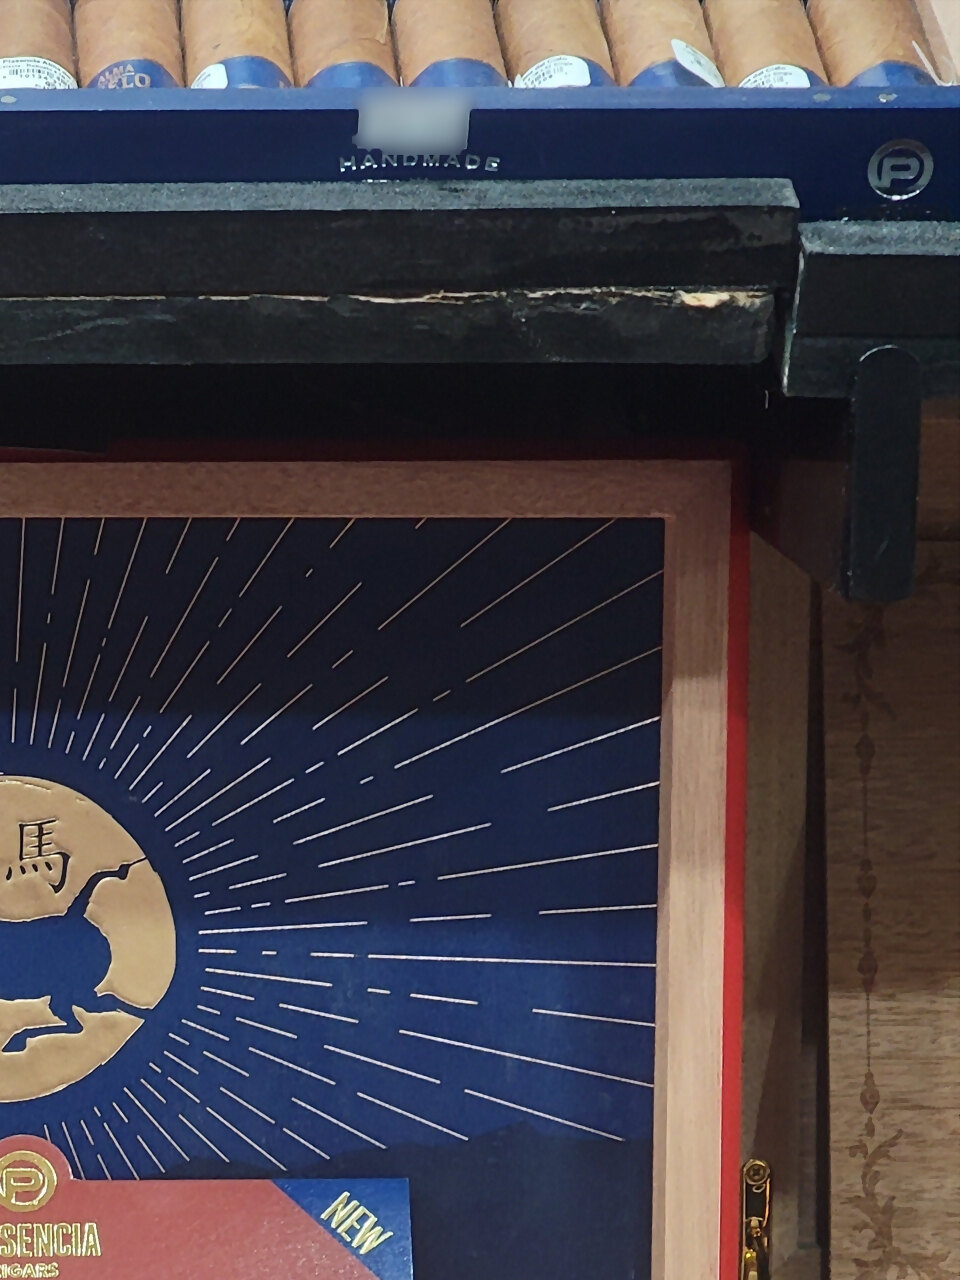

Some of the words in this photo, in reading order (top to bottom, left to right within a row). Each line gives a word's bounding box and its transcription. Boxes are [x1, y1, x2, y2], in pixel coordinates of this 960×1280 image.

[339, 154, 502, 172] HANDMADE
[6, 818, 70, 894] 馬
[320, 1190, 395, 1256] NEW
